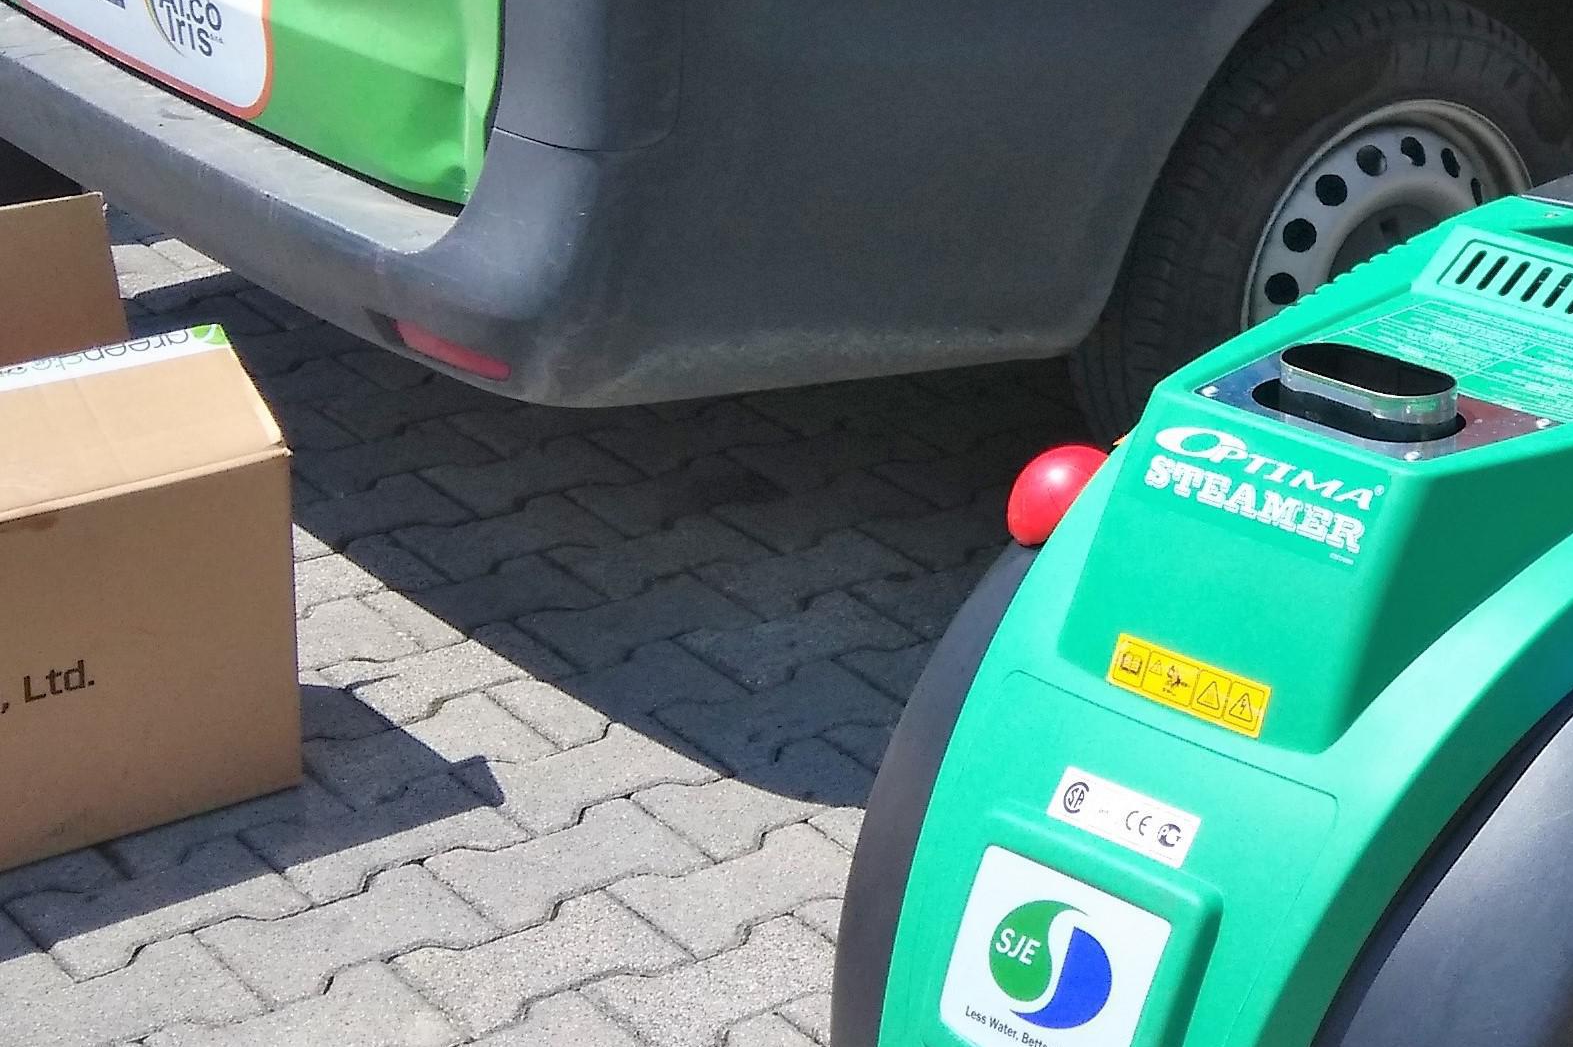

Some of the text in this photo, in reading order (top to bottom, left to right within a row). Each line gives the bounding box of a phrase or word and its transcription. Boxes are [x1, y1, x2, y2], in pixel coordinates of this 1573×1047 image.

[167, 5, 213, 57] Iris
[1145, 454, 1366, 554] STEAMER
[24, 659, 95, 703] Ltd.
[995, 928, 1041, 966] SJE
[965, 1005, 987, 1025] Less
